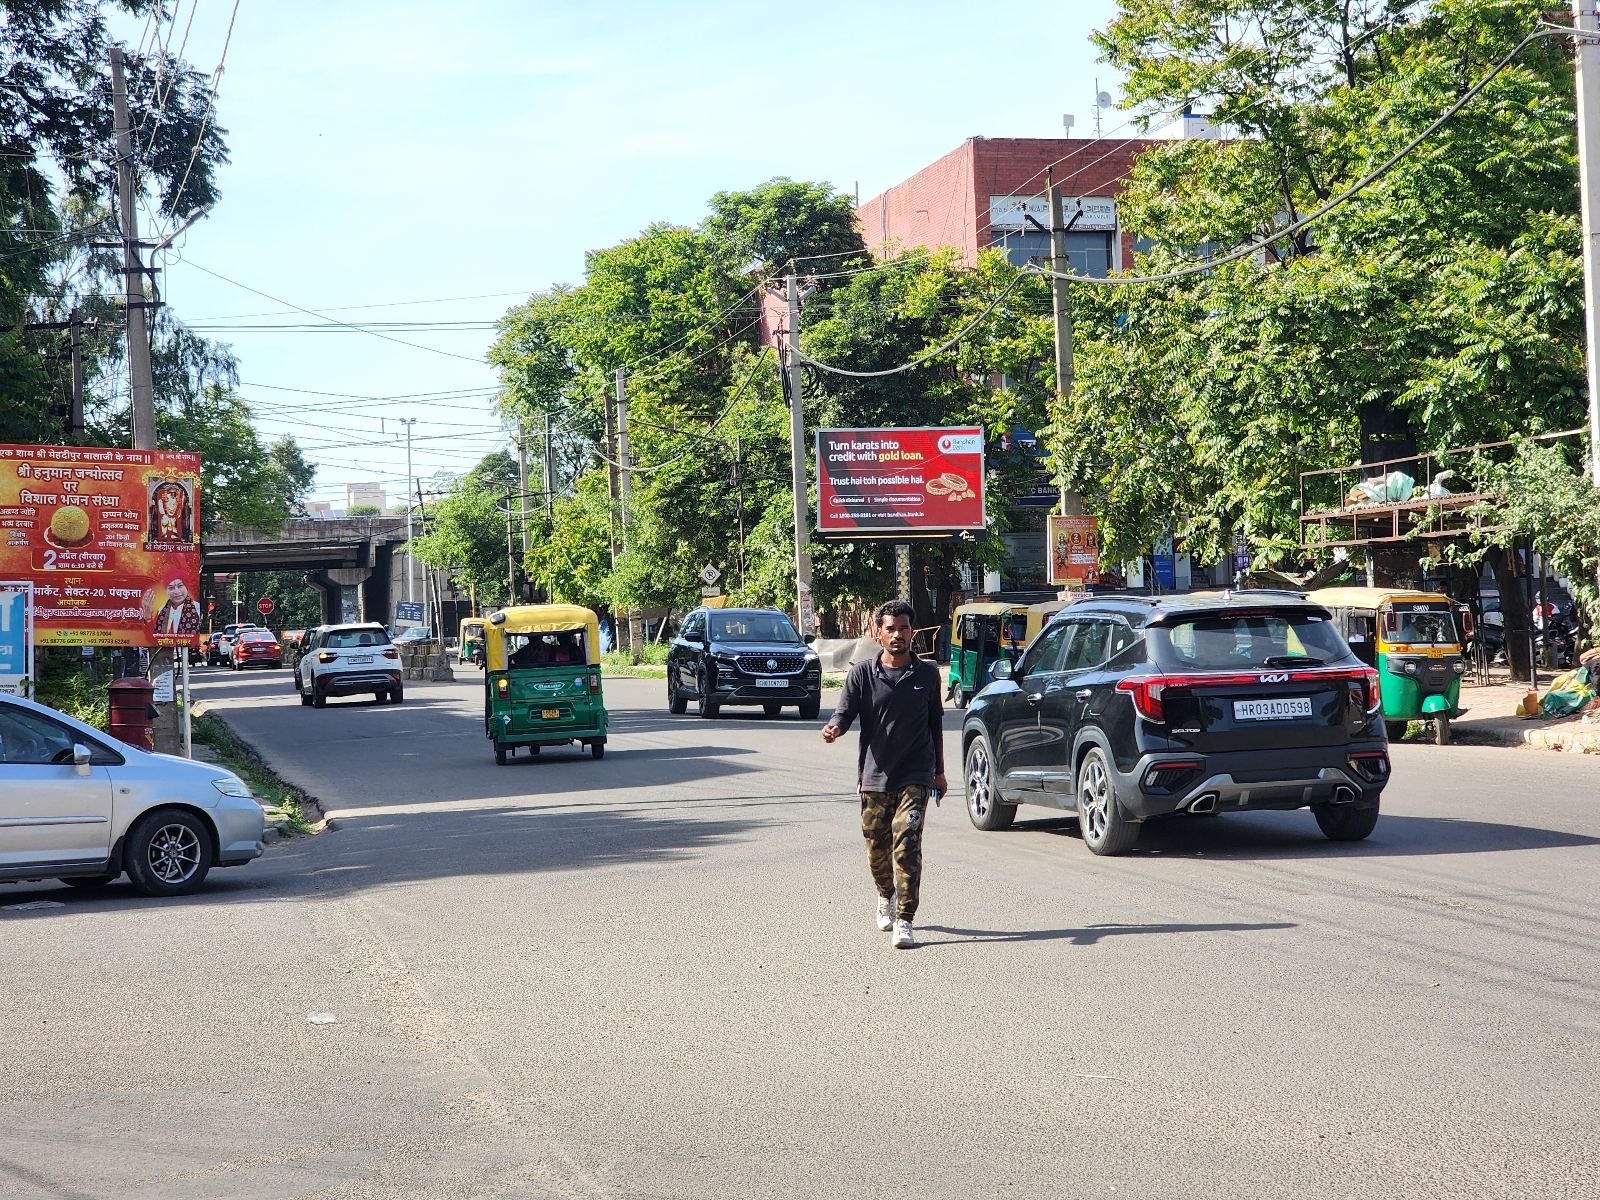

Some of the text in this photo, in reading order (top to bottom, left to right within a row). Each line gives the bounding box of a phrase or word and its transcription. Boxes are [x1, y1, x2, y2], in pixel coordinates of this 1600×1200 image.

[828, 440, 900, 450] Turn karats into
[16, 449, 34, 458] शाम
[36, 448, 46, 458] श्री
[83, 450, 113, 462] बालाजी
[115, 451, 124, 461] के
[125, 454, 142, 462] नाम
[828, 450, 924, 462] credit with gold loan.
[18, 463, 124, 481] श्री हनुमान जन्मोत्सव
[62, 481, 79, 493] पर
[829, 477, 851, 486] Trust
[851, 476, 863, 485] hai
[863, 476, 877, 485] toh
[878, 475, 910, 486] possible
[20, 490, 120, 507] विशाल भजन संध्या
[43, 549, 57, 570] 2
[1241, 701, 1311, 716] HR03AD0598
